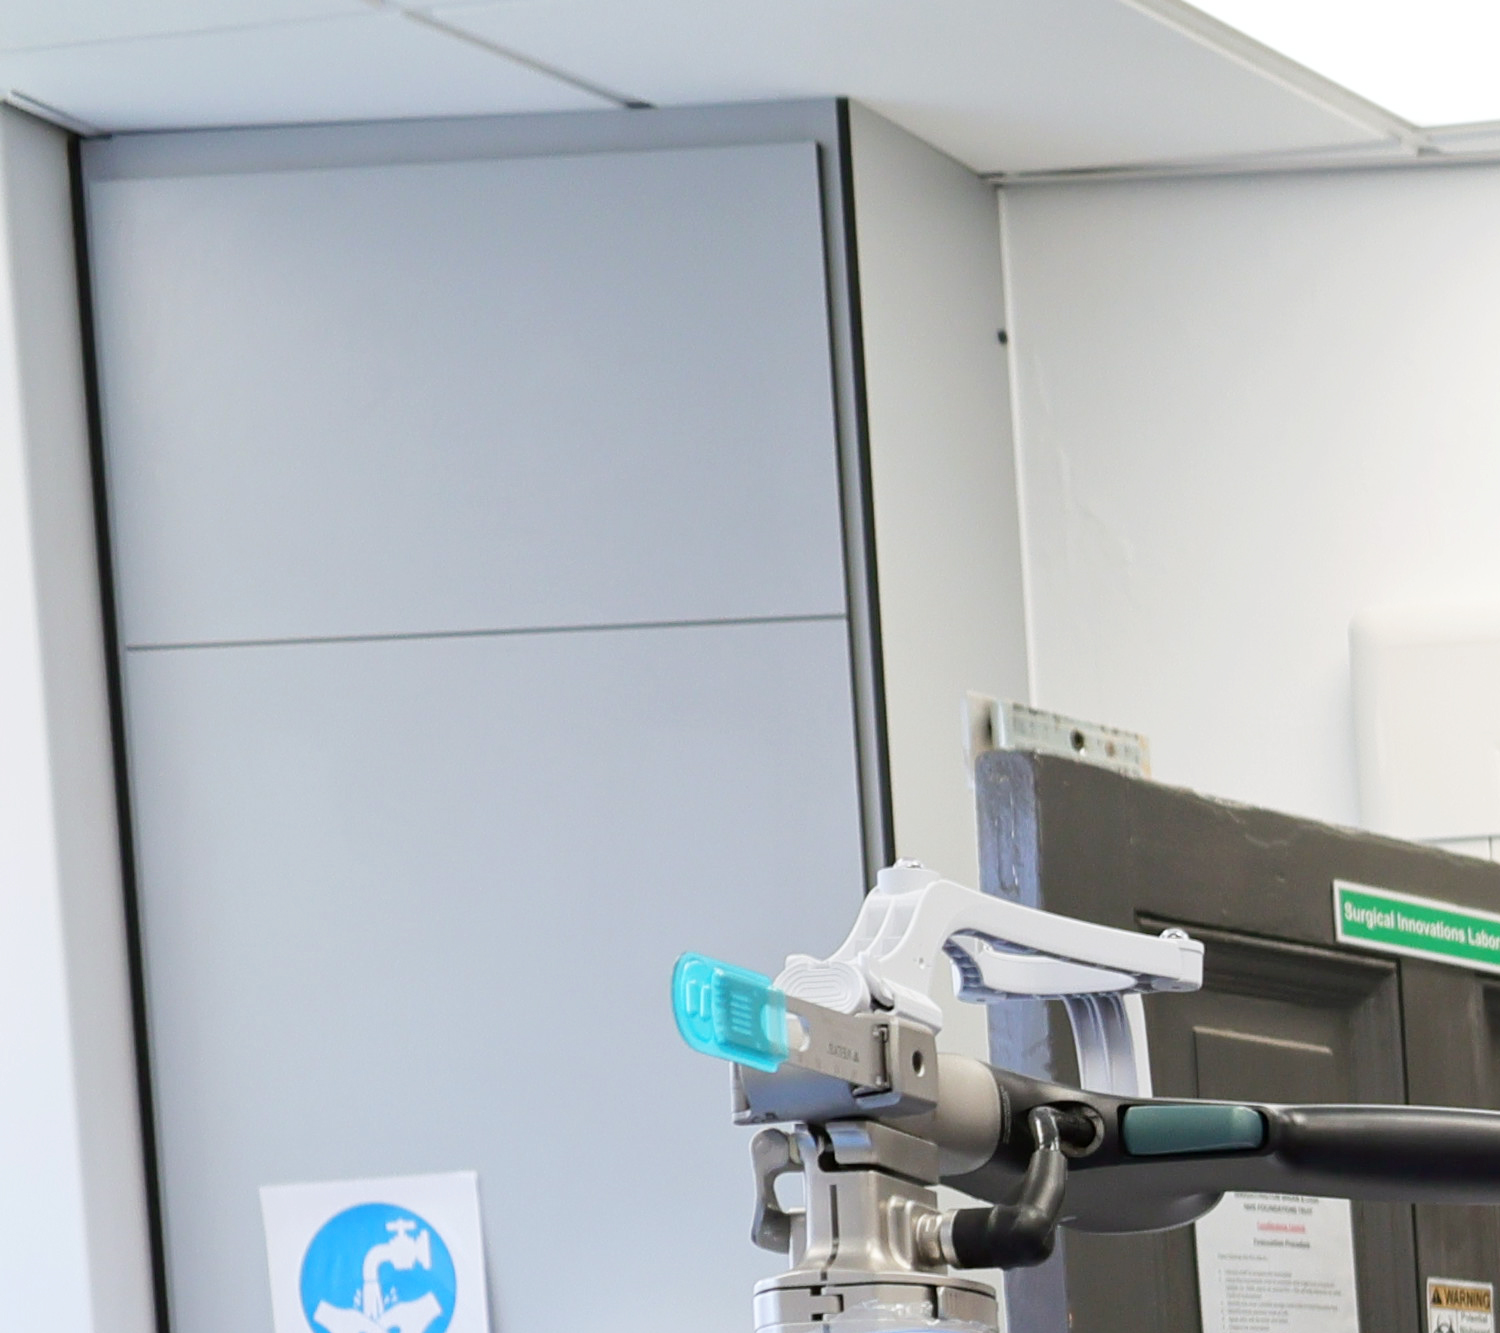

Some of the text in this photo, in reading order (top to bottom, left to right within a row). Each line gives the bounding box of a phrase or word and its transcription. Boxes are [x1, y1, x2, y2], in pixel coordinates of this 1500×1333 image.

[1344, 901, 1395, 930] Surgical
[1397, 911, 1466, 943] Innovations
[1444, 1289, 1490, 1309] WARNING
